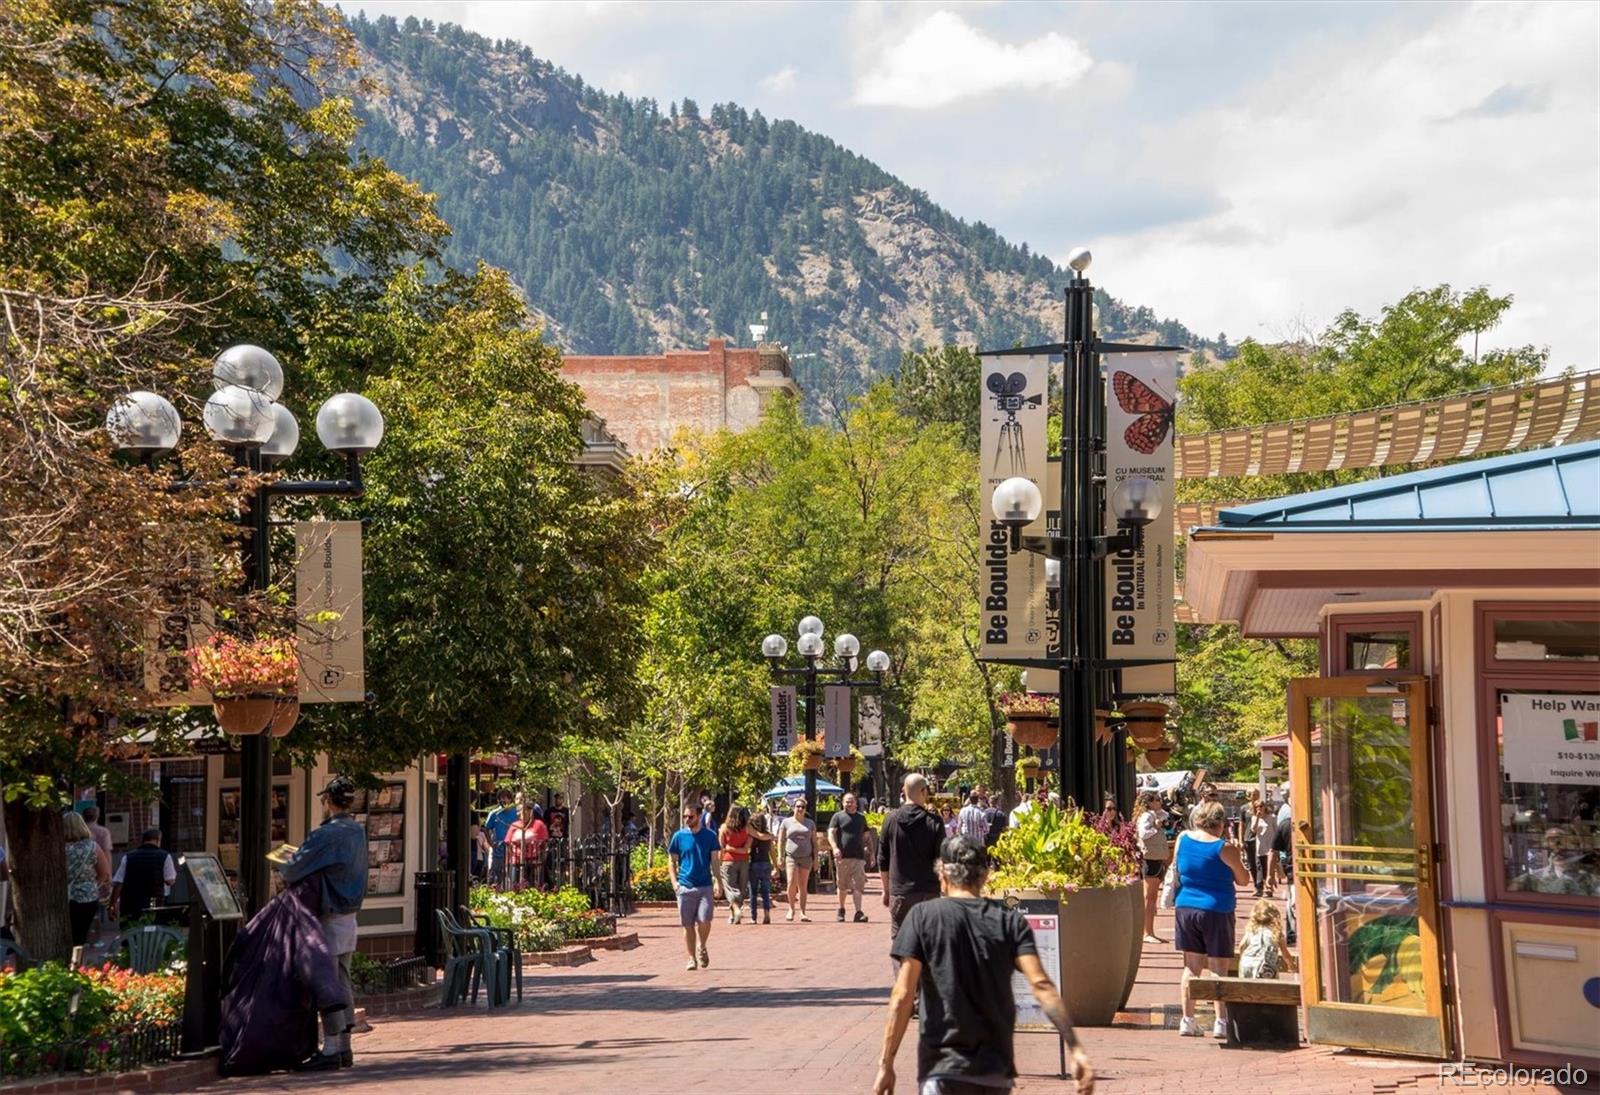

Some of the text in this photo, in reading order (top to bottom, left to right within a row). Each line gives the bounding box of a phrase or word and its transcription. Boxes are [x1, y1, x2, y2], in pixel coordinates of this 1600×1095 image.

[985, 520, 1008, 644] Be Boulder
[1136, 561, 1145, 599] NATURAL
[1136, 602, 1145, 610] In
[1112, 615, 1135, 645] Be
[1532, 699, 1567, 713] Help
[777, 738, 788, 752] Be
[1550, 769, 1583, 778] Inquire
